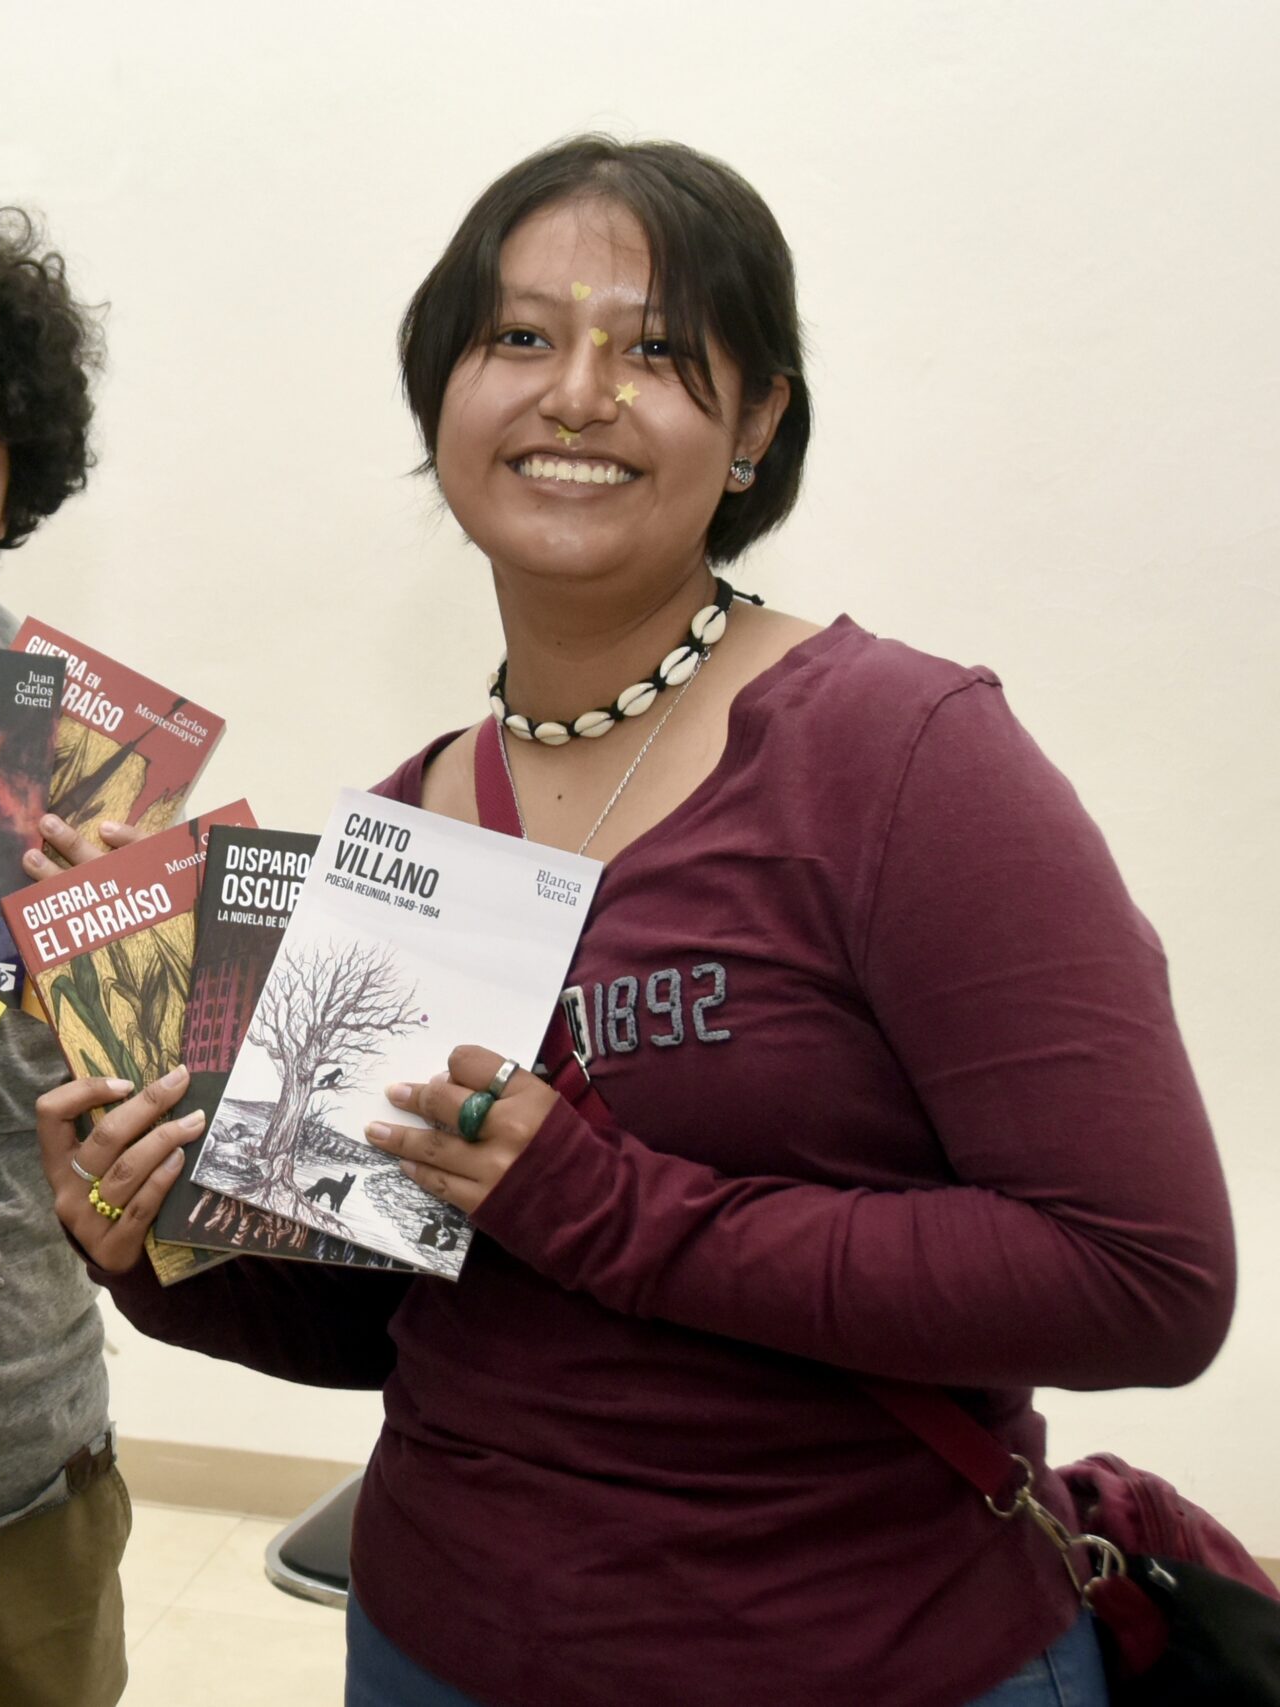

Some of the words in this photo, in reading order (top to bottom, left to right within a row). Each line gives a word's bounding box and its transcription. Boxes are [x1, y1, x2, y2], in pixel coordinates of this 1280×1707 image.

[15, 682, 54, 697] Carlos
[27, 671, 55, 685] Juan
[85, 672, 102, 690] EN
[14, 694, 52, 709] Onetti
[134, 703, 205, 748] Montemayor
[173, 711, 209, 737] Carlos
[344, 812, 411, 853] CANTO
[334, 840, 440, 898] VILLANO
[535, 869, 582, 894] Blanca
[22, 880, 100, 930] GUERRA
[100, 879, 119, 898] EN
[324, 872, 355, 892] POESÍA
[355, 881, 392, 905] REUNIDA,
[392, 894, 441, 920] 1949-1994
[536, 883, 578, 907] Varela
[33, 926, 70, 963] EL
[67, 882, 172, 949] PARAÍSO
[217, 910, 230, 922] LA
[230, 911, 264, 926] NOVELA
[266, 915, 277, 928] DE
[594, 962, 731, 1055] 1892
